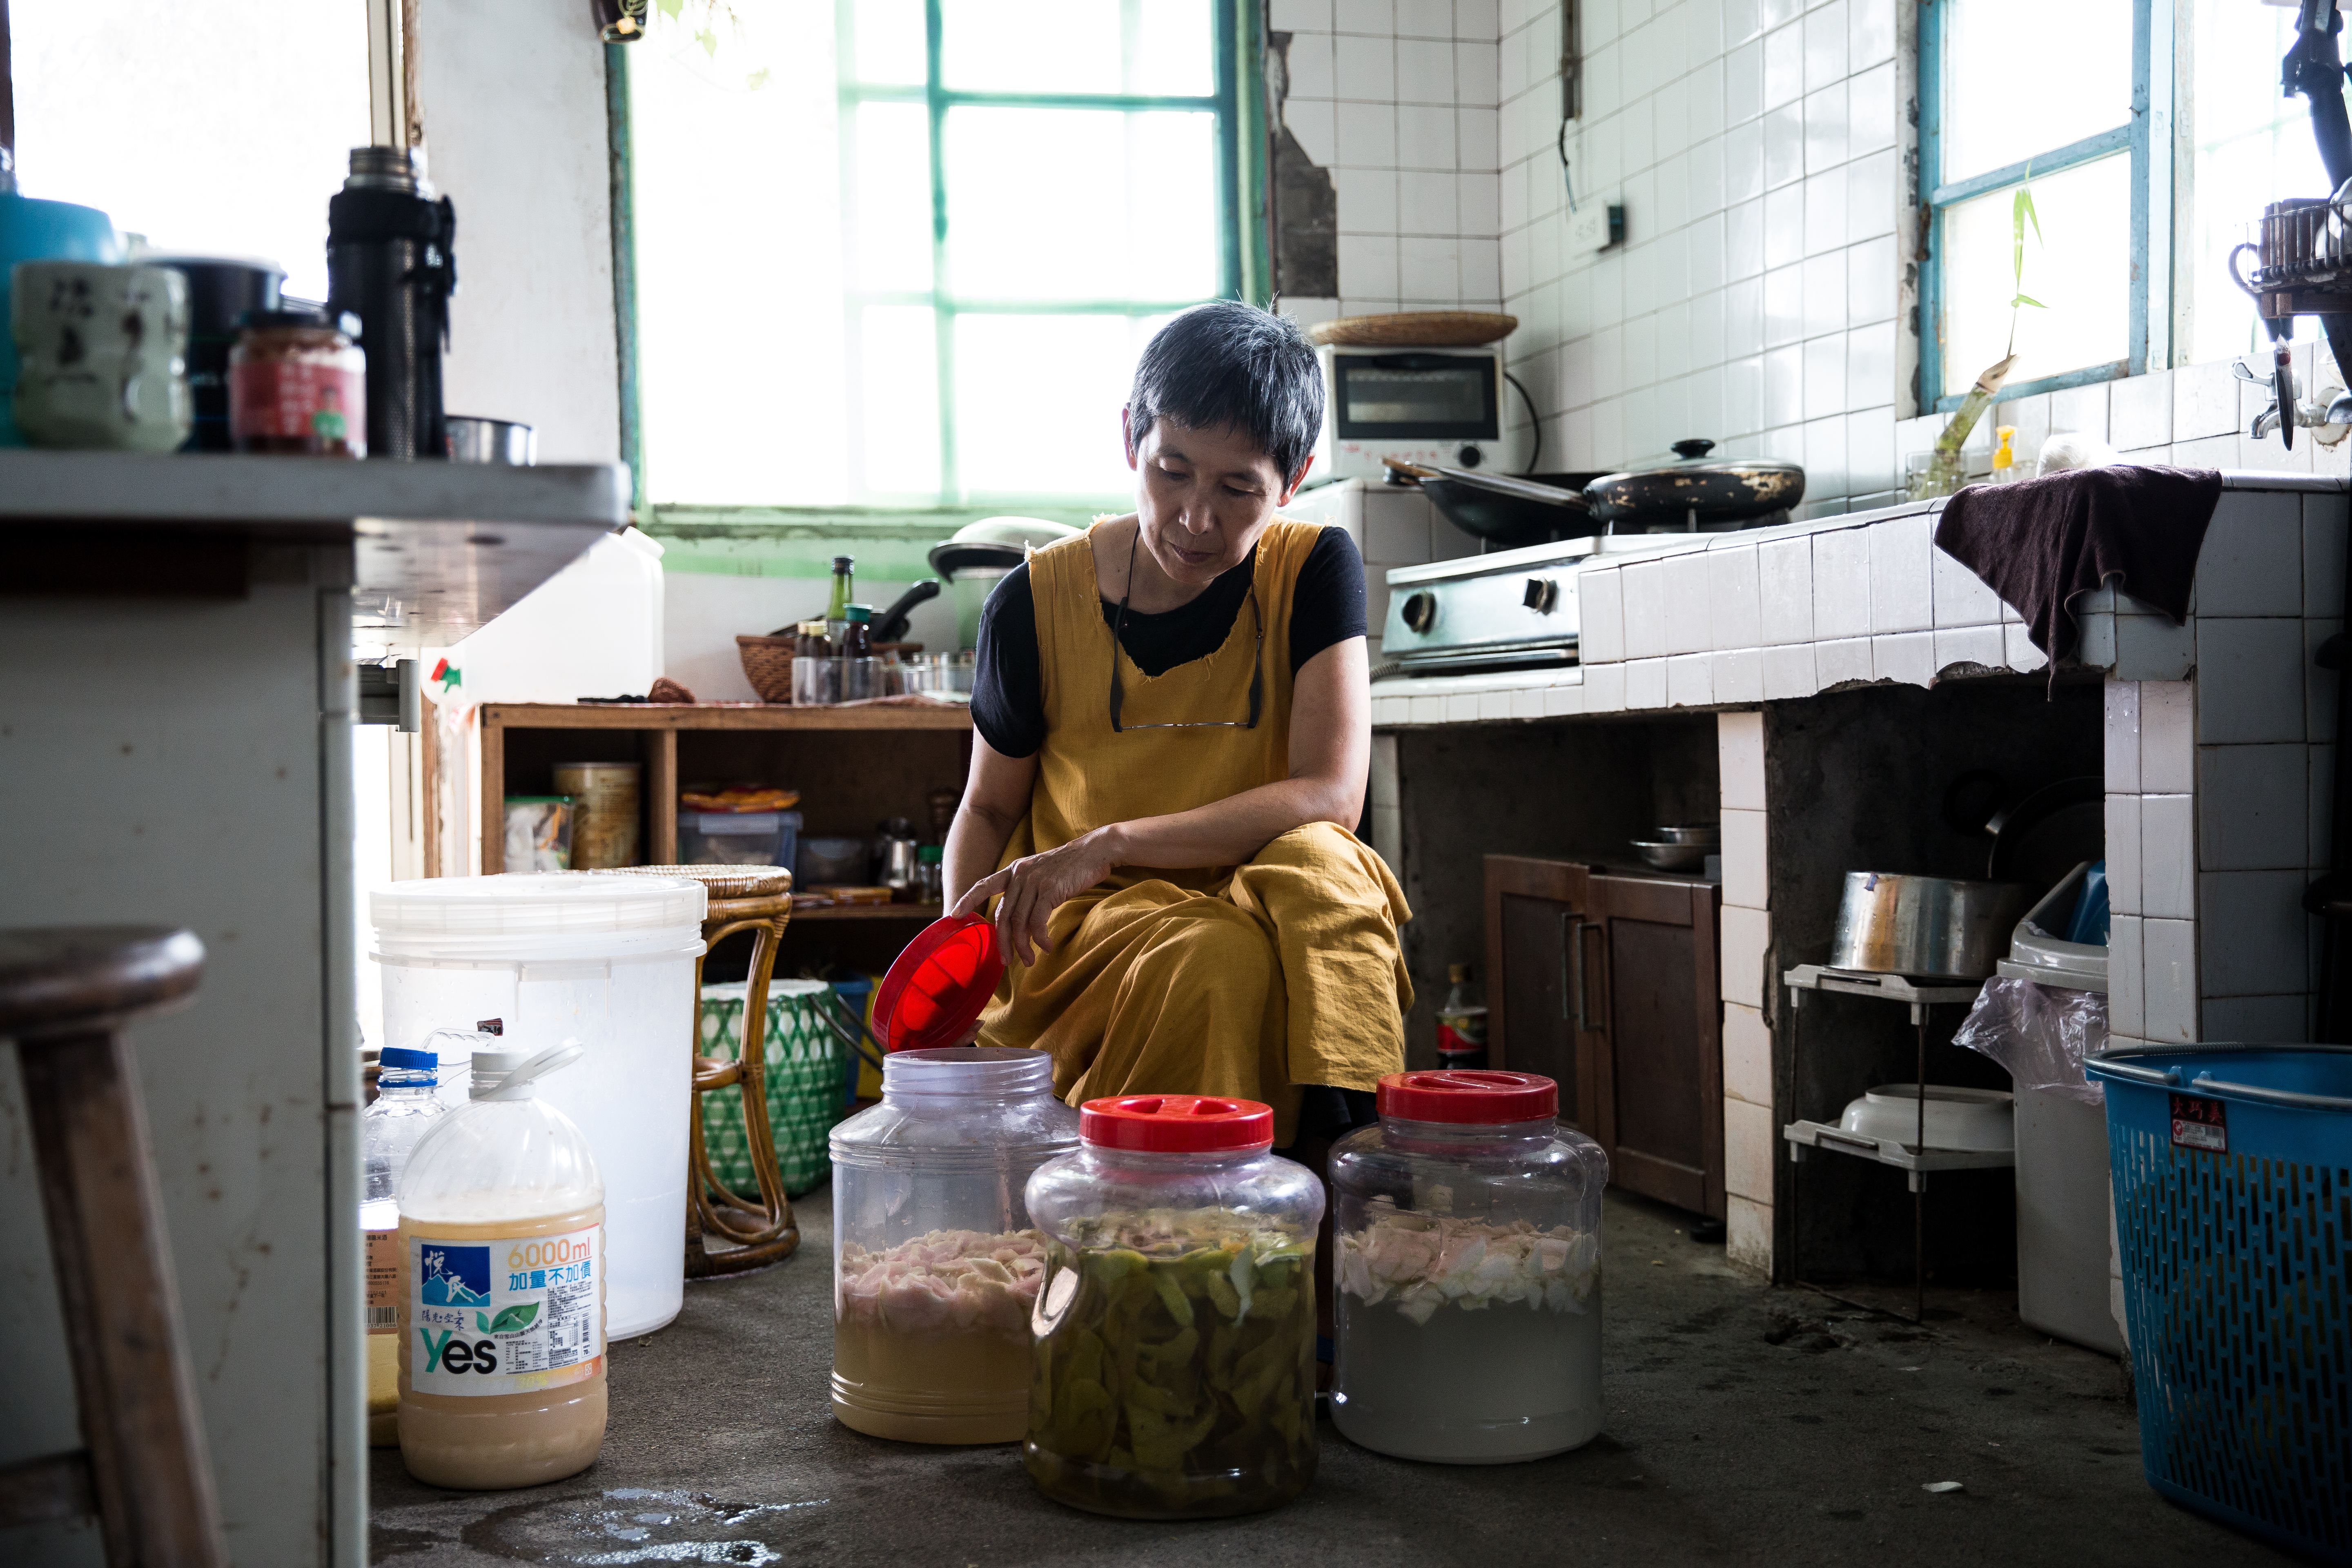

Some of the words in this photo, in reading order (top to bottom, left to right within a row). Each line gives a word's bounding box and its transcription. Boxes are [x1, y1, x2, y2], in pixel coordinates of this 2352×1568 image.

[508, 1236, 590, 1269] 6000ml
[425, 1250, 474, 1303] 悅氏
[509, 1260, 591, 1291] 加量不加價
